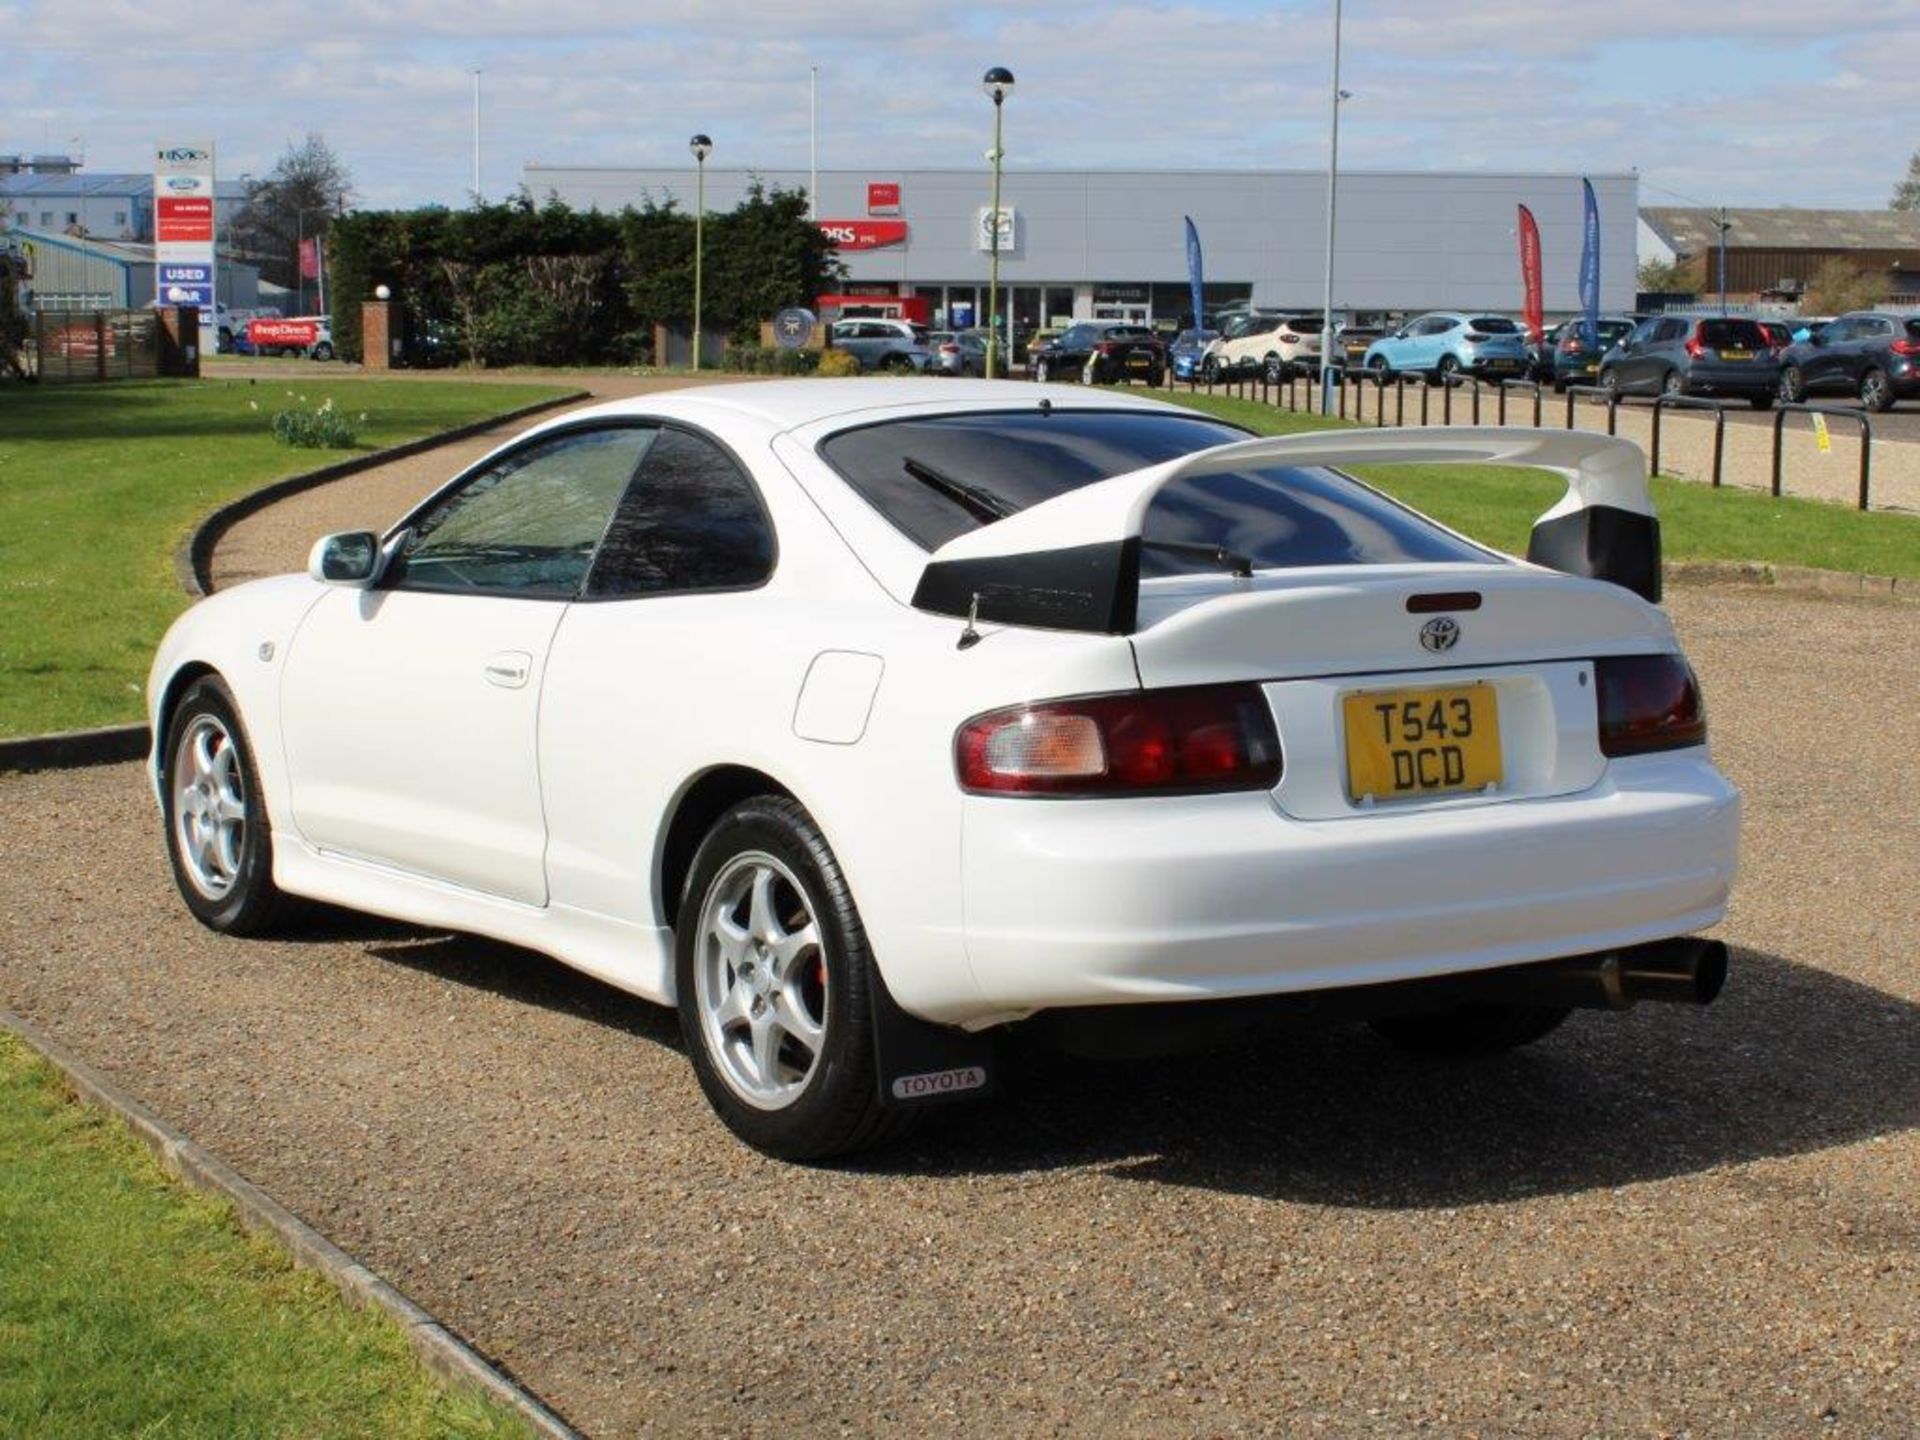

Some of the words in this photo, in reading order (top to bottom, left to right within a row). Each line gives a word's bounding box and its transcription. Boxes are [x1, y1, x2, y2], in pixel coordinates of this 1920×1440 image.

[166, 269, 205, 281] USED
[1375, 698, 1472, 744] T543
[1391, 745, 1464, 790] DCD
[902, 1070, 978, 1094] TOYOTA
